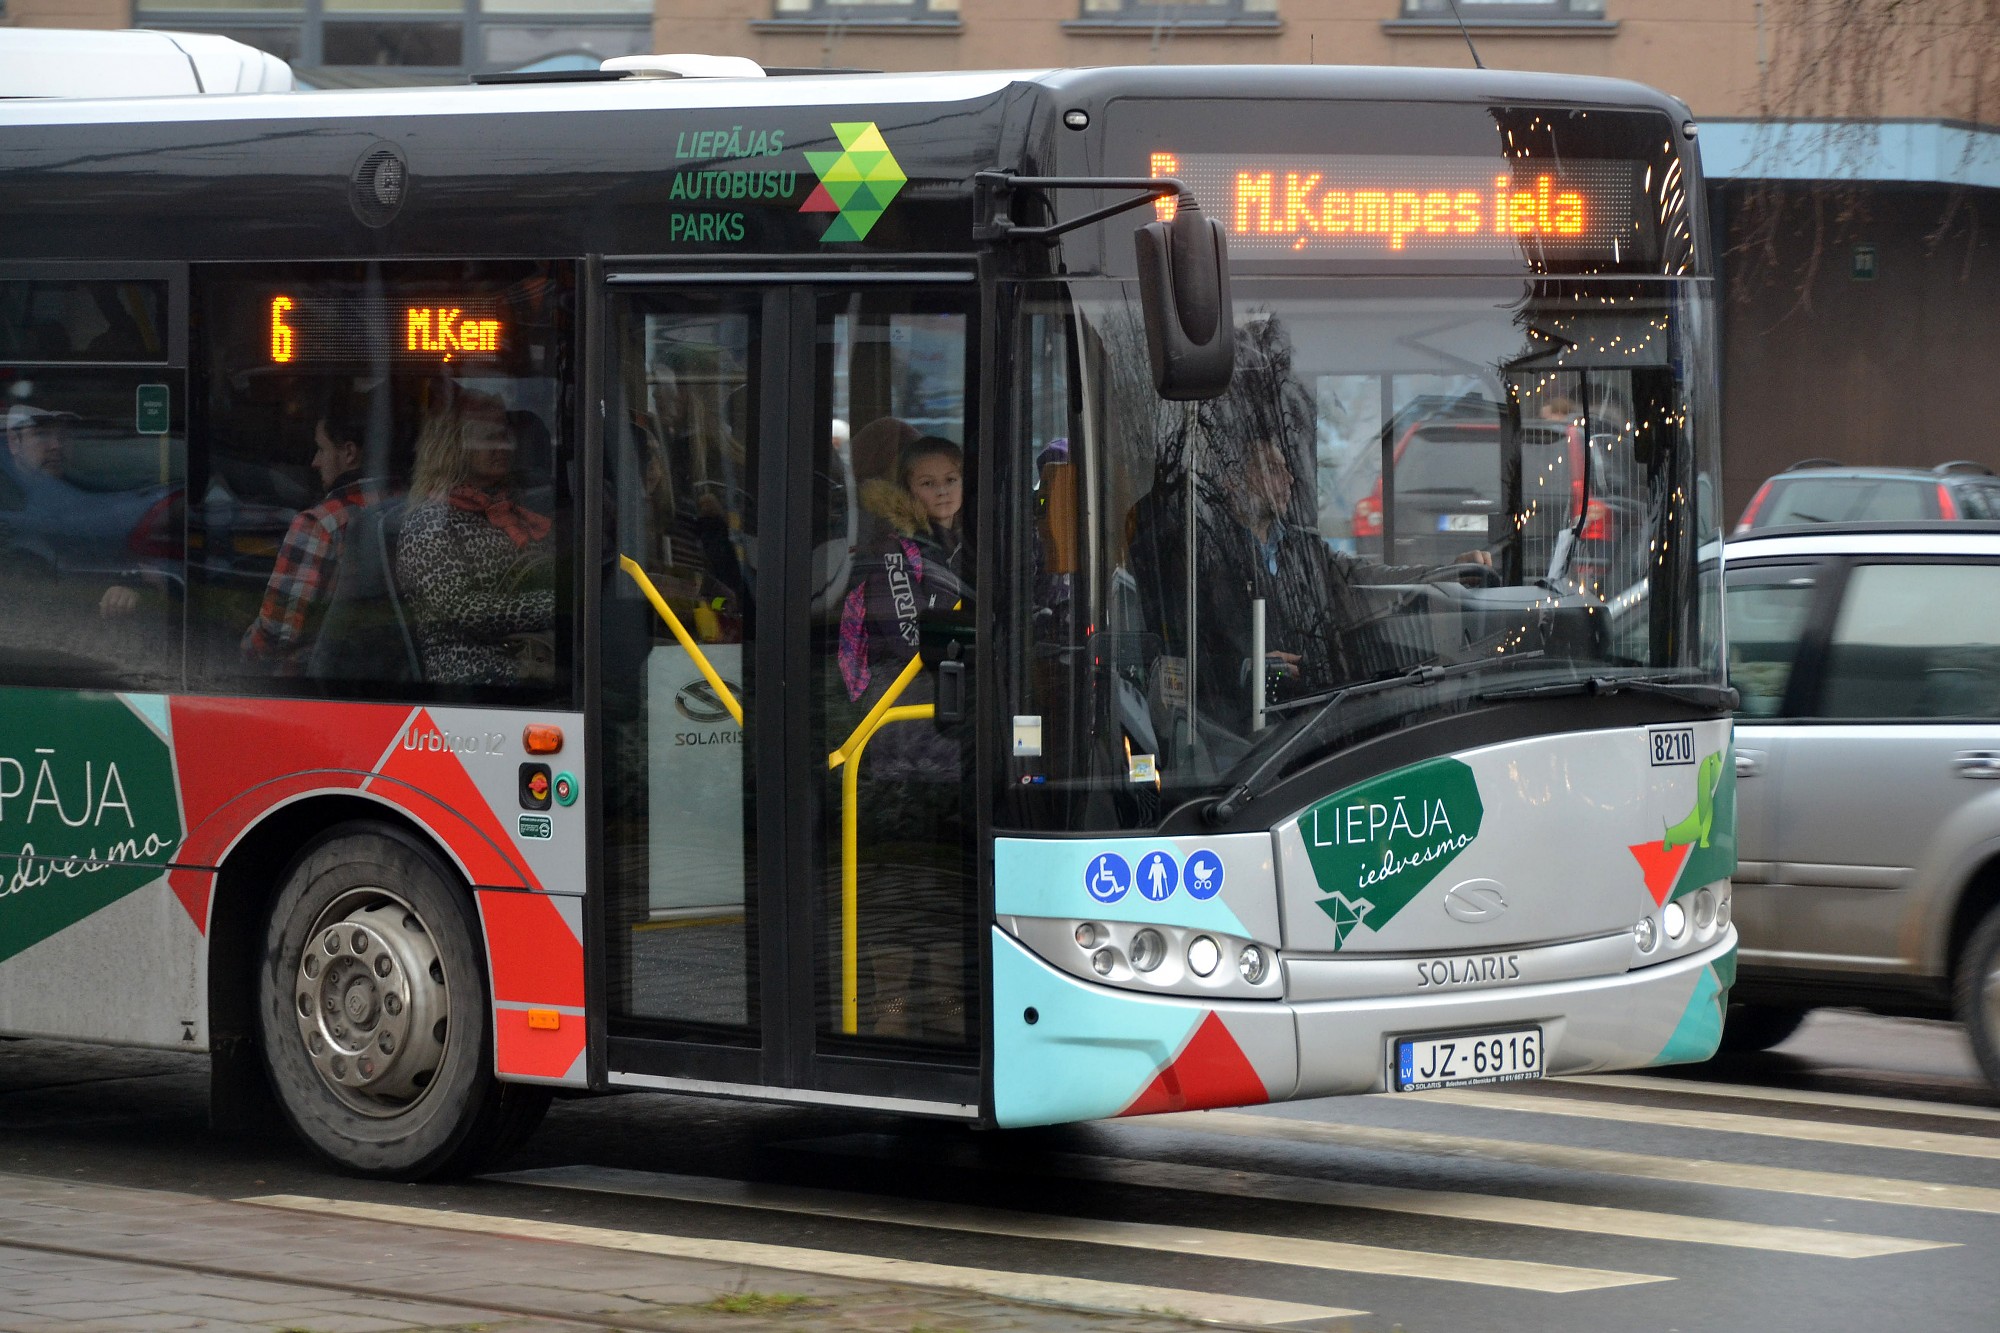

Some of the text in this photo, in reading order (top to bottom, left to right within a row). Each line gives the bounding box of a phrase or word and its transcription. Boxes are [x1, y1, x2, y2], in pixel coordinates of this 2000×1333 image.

[675, 125, 785, 158] LIEPĀJAS
[669, 170, 796, 200] AUTOBUSU
[671, 212, 745, 241] PARKS
[1236, 172, 1481, 250] M.Ķempes
[1495, 174, 1584, 234] iela
[272, 297, 292, 362] 6
[404, 727, 506, 756] Urbino 12
[1654, 732, 1691, 761] 8210
[1314, 795, 1452, 847] LIEPĀJA
[1417, 955, 1520, 987] SOLARIS
[1401, 1036, 1536, 1079] LV JZ-6916
[1415, 1081, 1442, 1091] SOLARIS
